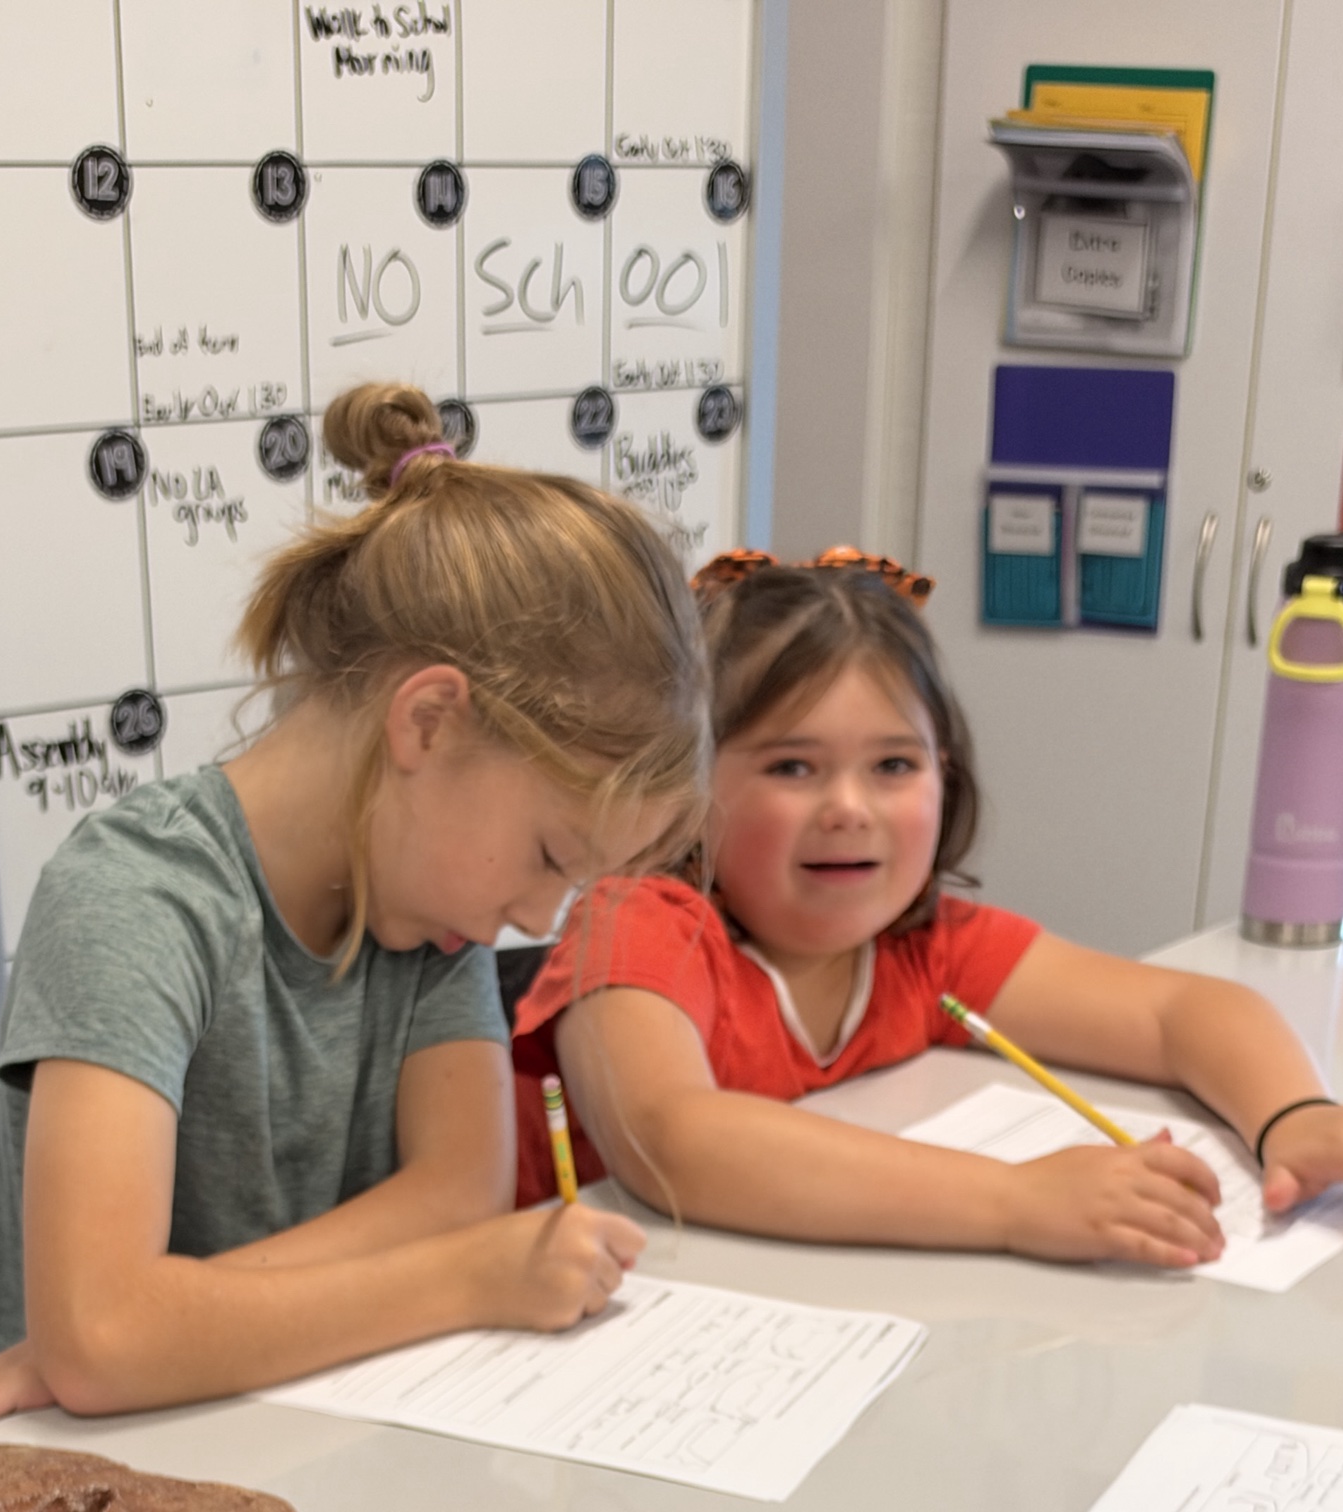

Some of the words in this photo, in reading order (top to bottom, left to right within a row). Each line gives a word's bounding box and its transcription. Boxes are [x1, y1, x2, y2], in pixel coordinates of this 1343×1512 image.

[332, 43, 436, 103] Morning
[84, 156, 120, 200] 12
[261, 161, 298, 204] 13
[423, 169, 460, 214] 14
[579, 165, 608, 206] 15
[1069, 228, 1121, 252] Extra
[335, 242, 423, 328] NO
[1061, 261, 1124, 289] Copies
[96, 443, 138, 488] 19
[264, 425, 308, 471] 20
[613, 431, 698, 481] Buddies
[173, 496, 250, 548] groups
[117, 699, 161, 744] 26
